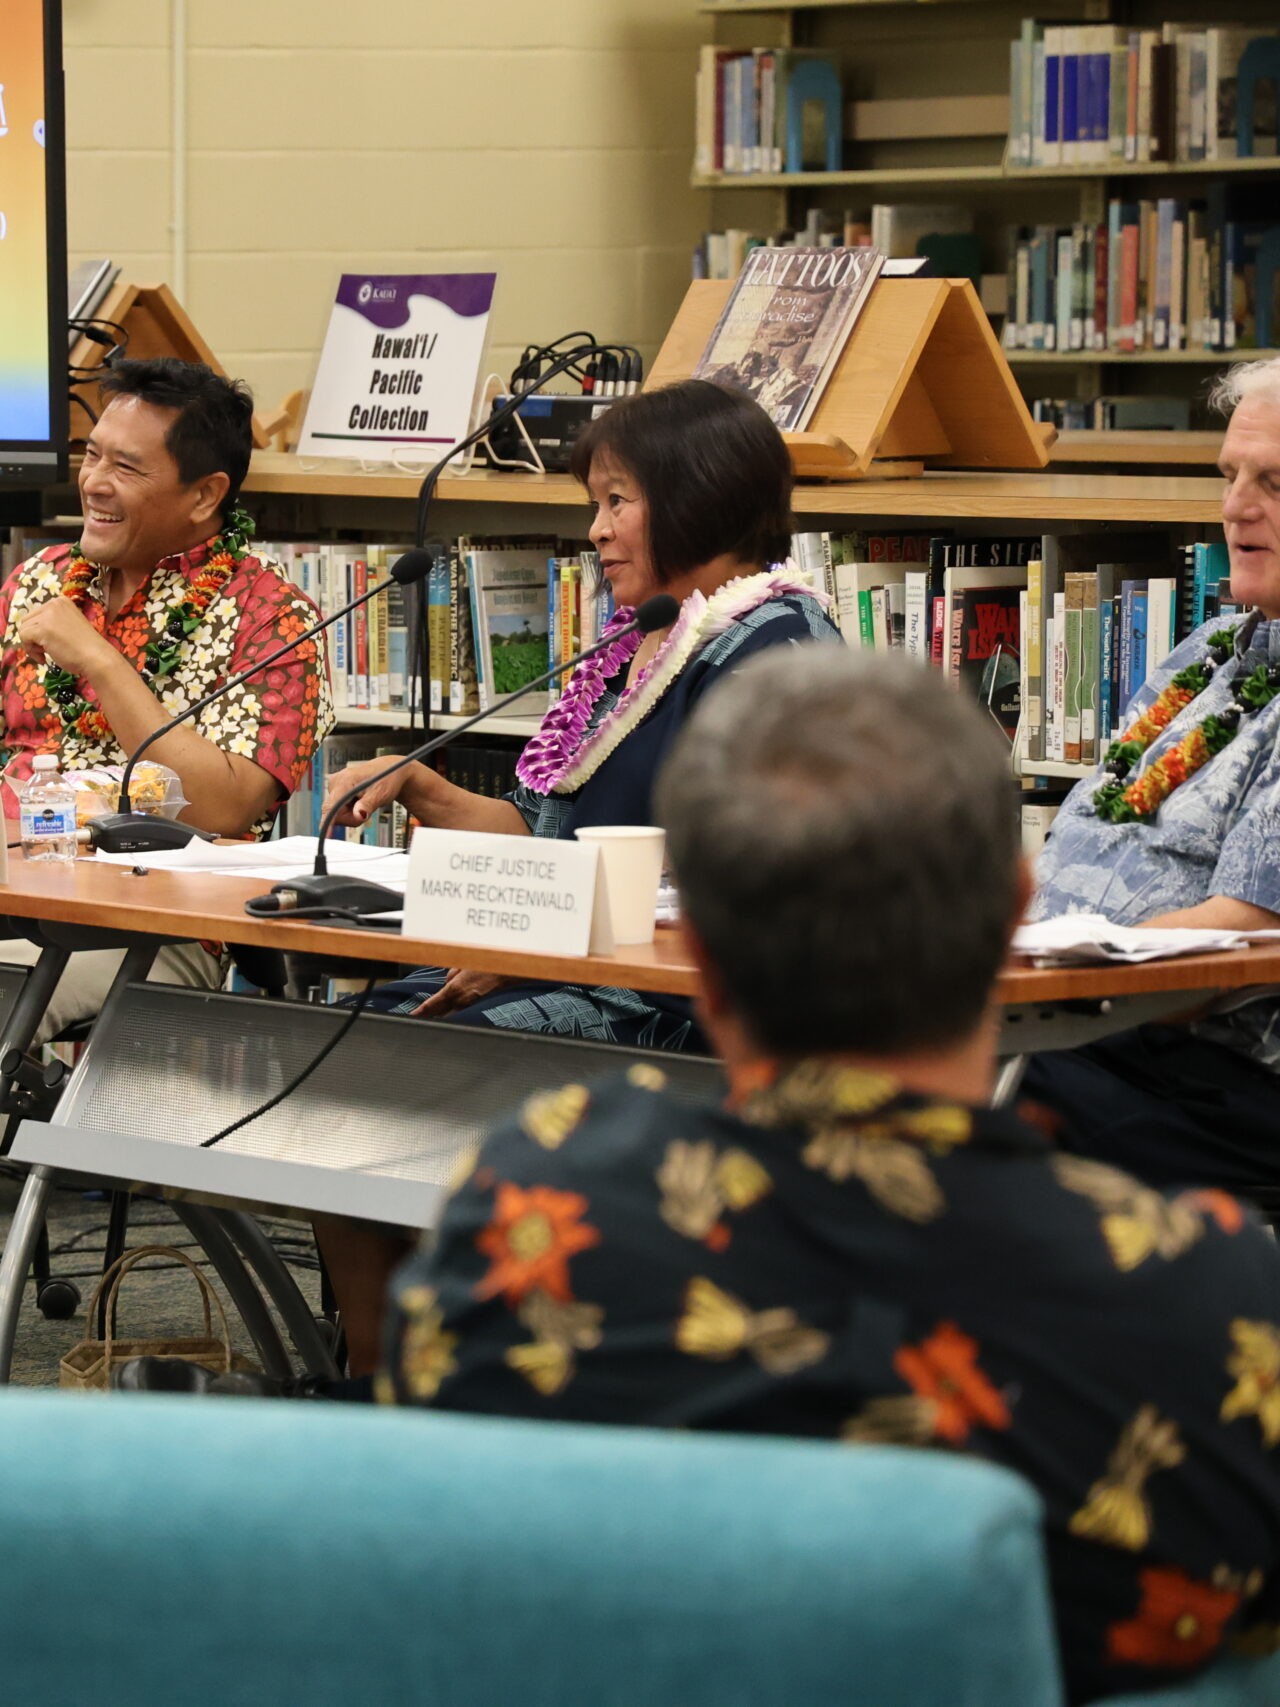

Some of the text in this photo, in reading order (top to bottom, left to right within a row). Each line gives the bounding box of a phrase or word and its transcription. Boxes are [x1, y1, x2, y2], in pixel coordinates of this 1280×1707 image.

[741, 253, 867, 288] TATTOOS
[746, 305, 815, 323] radise
[369, 370, 423, 394] Pacific
[348, 404, 429, 431] Collection
[822, 540, 831, 561] PEARL
[943, 543, 1041, 567] THE SIEG
[429, 559, 437, 593] TOLL
[438, 556, 446, 576] IAN
[1193, 583, 1202, 618] PACIFIC
[450, 559, 458, 679] WAR IN THE PACIFIC
[910, 612, 919, 633] The
[336, 622, 344, 643] AND
[437, 617, 446, 662] PACIFIC
[336, 645, 344, 669] WAR
[450, 852, 556, 880] CHIEF JUSTICE
[421, 879, 578, 912] MARK RECKTENWALD,
[466, 908, 530, 931] RETIRED
